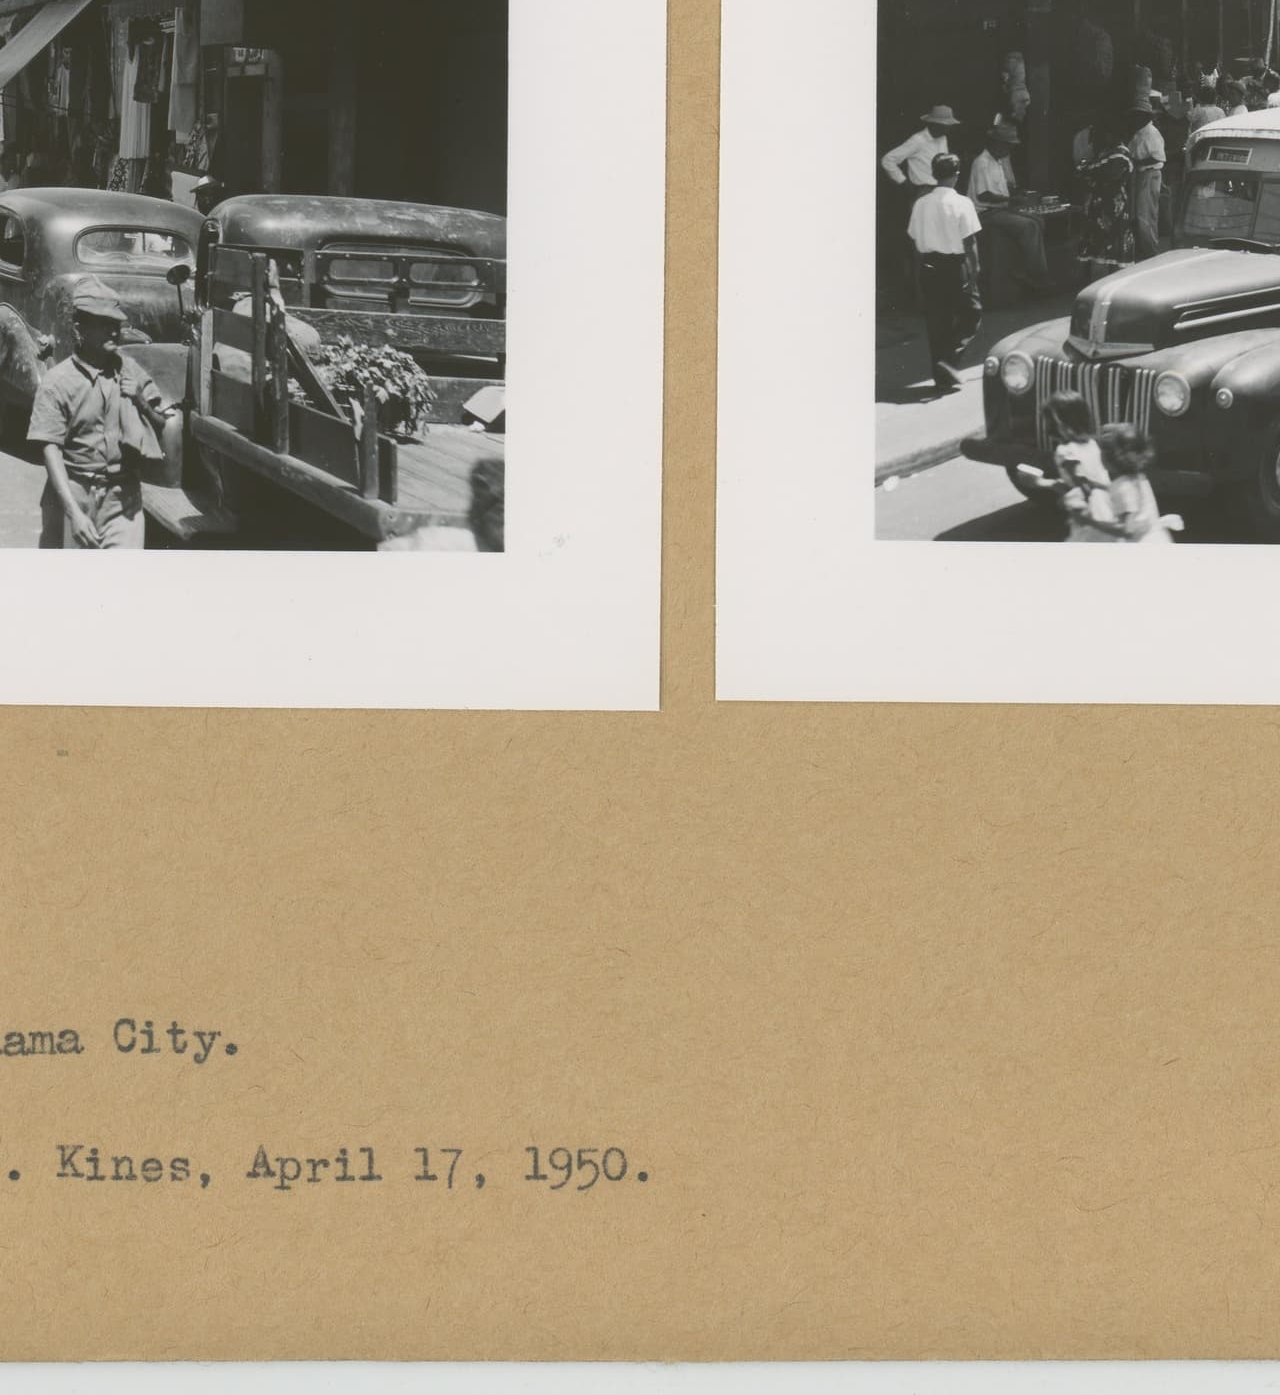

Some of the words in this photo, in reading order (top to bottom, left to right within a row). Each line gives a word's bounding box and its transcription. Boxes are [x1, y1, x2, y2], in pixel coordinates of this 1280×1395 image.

[113, 1017, 239, 1065] City.
[56, 1144, 211, 1190] Kines,
[245, 1145, 383, 1191] April
[414, 1146, 486, 1190] 17,
[524, 1146, 649, 1191] 1950.
